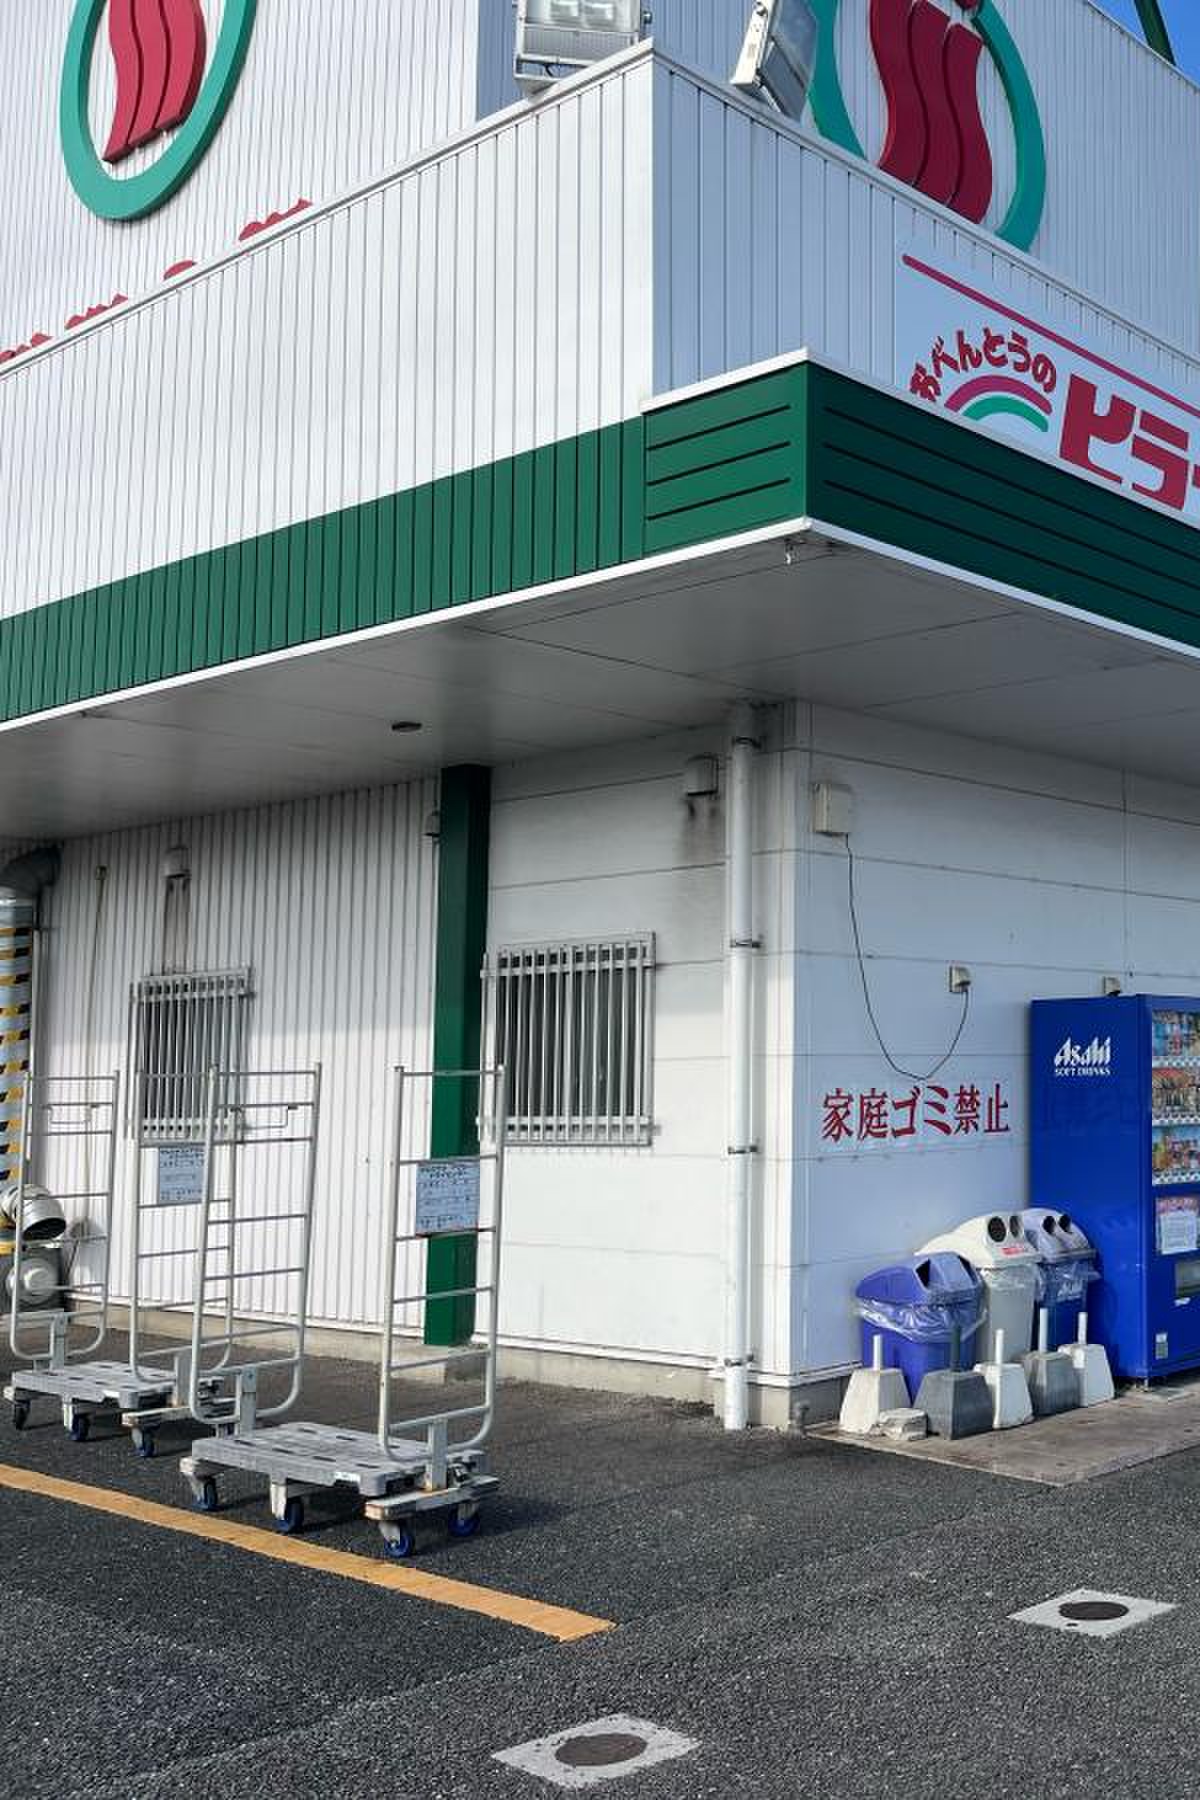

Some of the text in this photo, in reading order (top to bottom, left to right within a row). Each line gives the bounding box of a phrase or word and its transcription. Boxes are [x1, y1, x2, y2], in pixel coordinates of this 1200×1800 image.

[910, 327, 1057, 402] おべんとうの
[1054, 1036, 1112, 1067] Asahi
[821, 1083, 1010, 1142] 家庭ゴミ禁止
